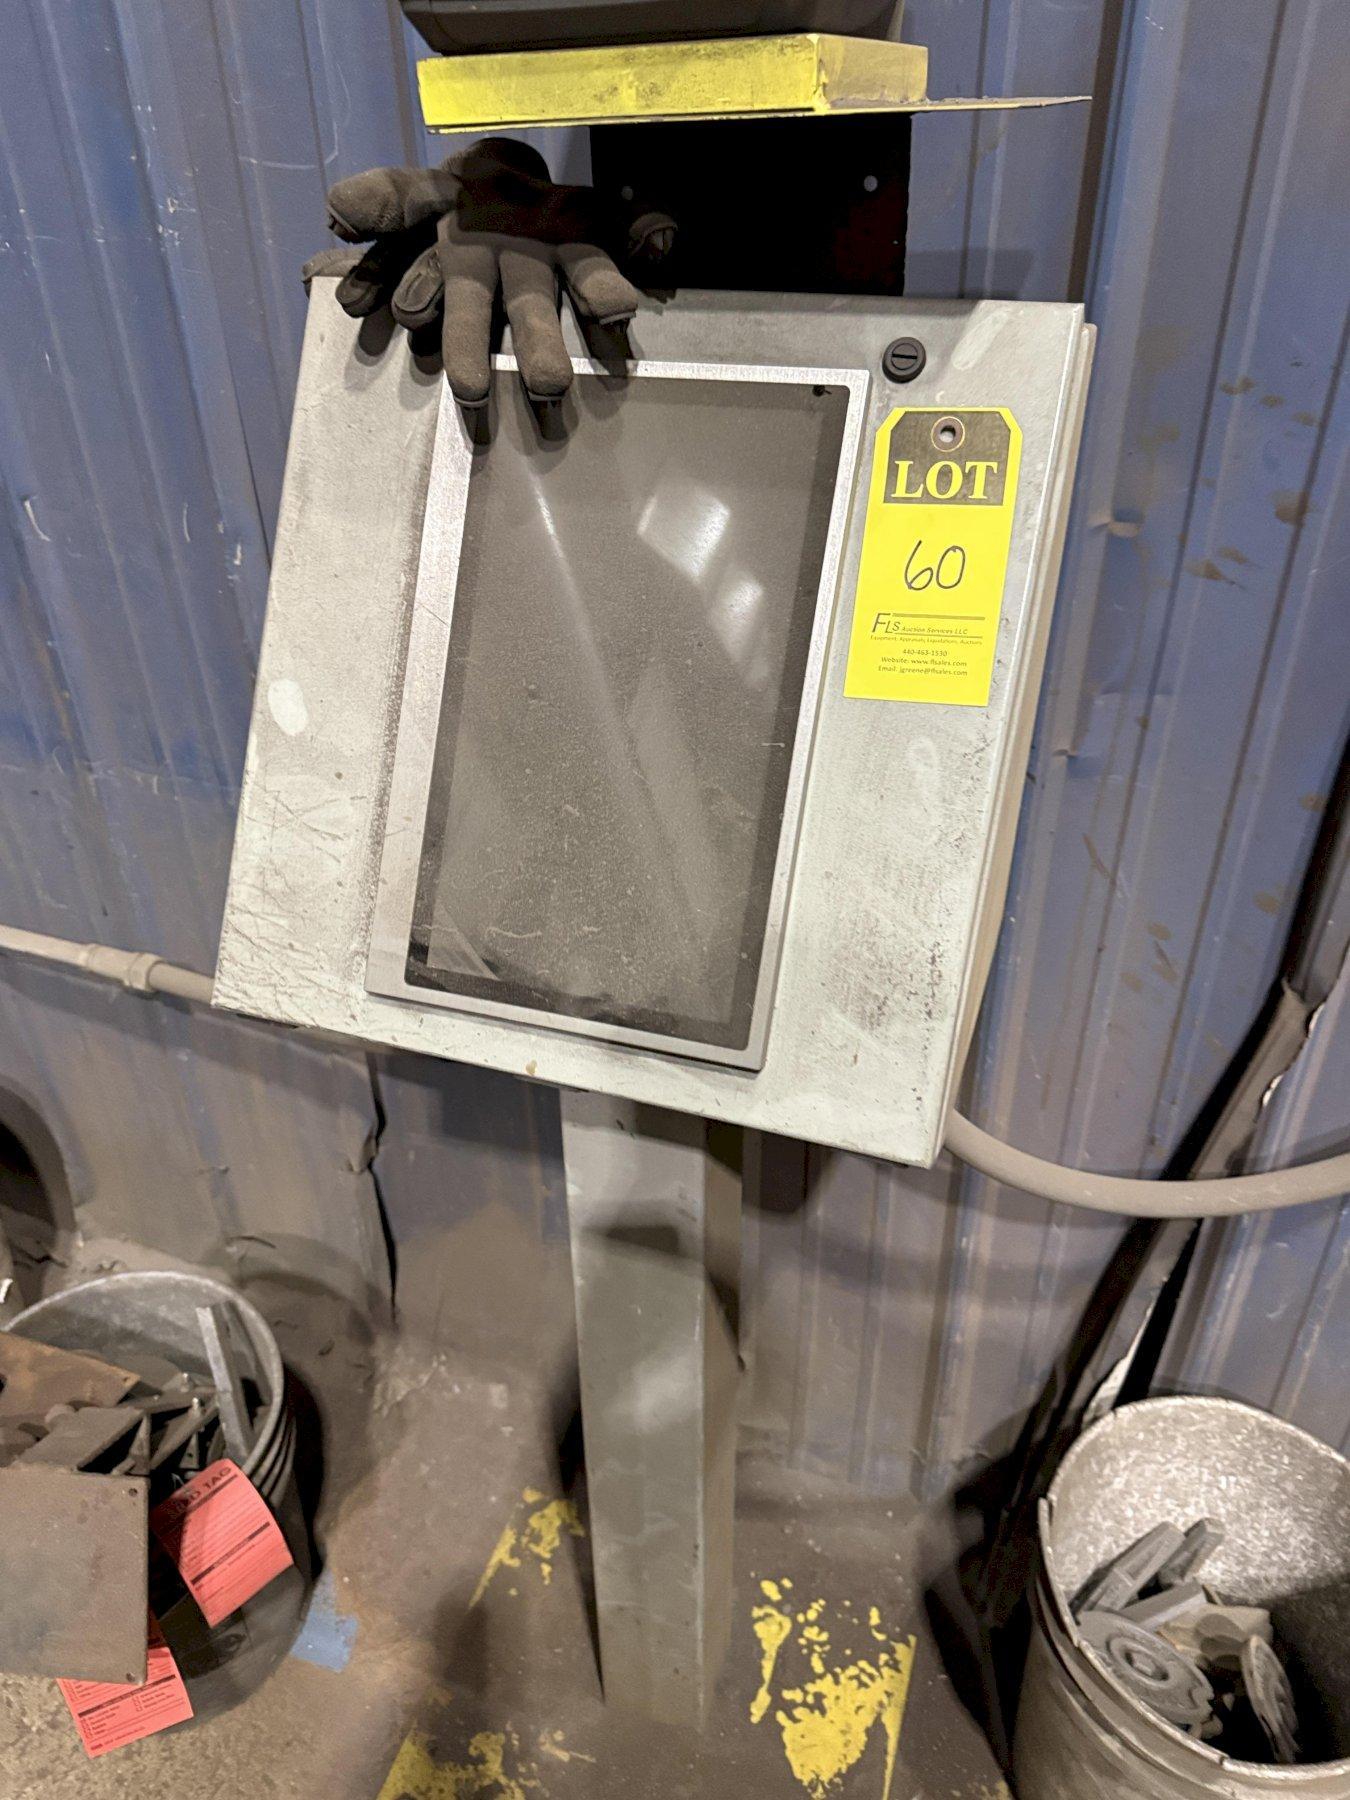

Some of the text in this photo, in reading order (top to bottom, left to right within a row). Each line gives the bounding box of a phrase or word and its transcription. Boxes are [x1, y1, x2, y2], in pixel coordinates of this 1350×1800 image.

[891, 460, 998, 499] LOT
[904, 539, 966, 591] 60
[872, 613, 900, 633] FLS
[927, 627, 953, 635] Services
[881, 656, 910, 664] Website:
[902, 648, 948, 657] 440-463-1530
